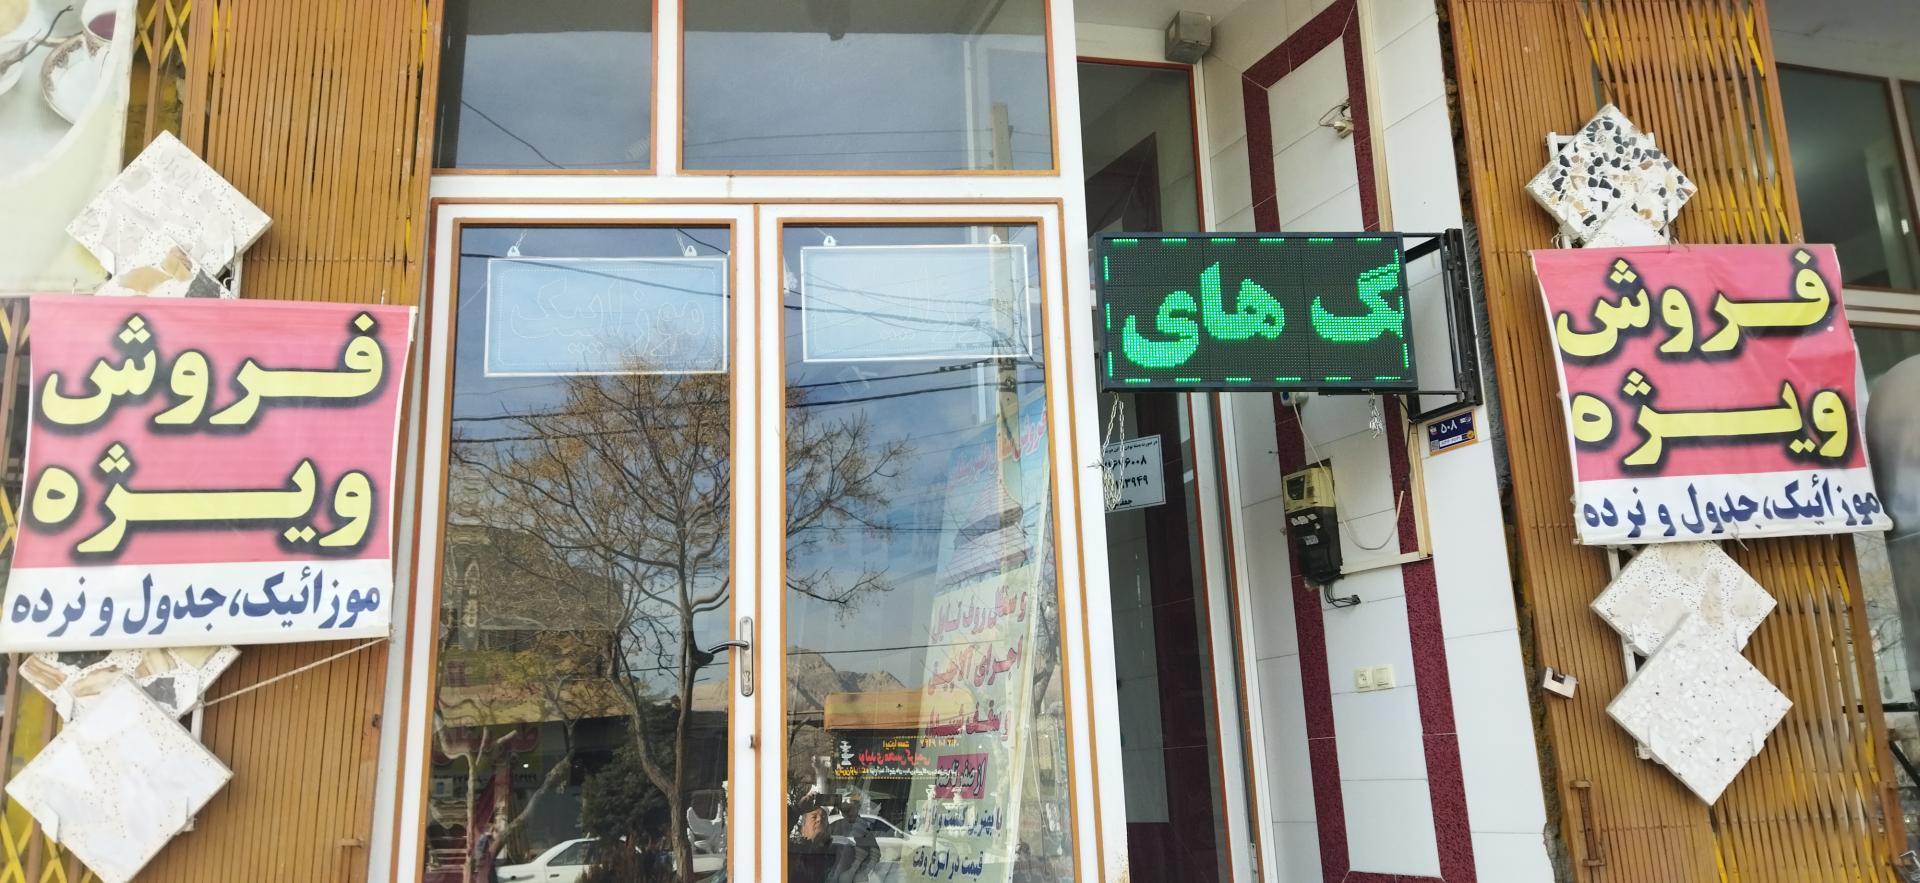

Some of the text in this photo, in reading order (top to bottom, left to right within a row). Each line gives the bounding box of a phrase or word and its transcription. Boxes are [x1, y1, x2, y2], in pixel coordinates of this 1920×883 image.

[1122, 261, 1286, 369] های
[1556, 249, 1831, 357] فروش
[40, 313, 384, 426] فروش
[1440, 419, 1458, 434] ۵۰۸
[1571, 371, 1849, 467] ویژه
[31, 443, 374, 554] ویژه
[1583, 487, 1648, 538] نرده
[1656, 502, 1677, 537] و
[10, 576, 86, 638] نرده
[89, 596, 114, 637] و
